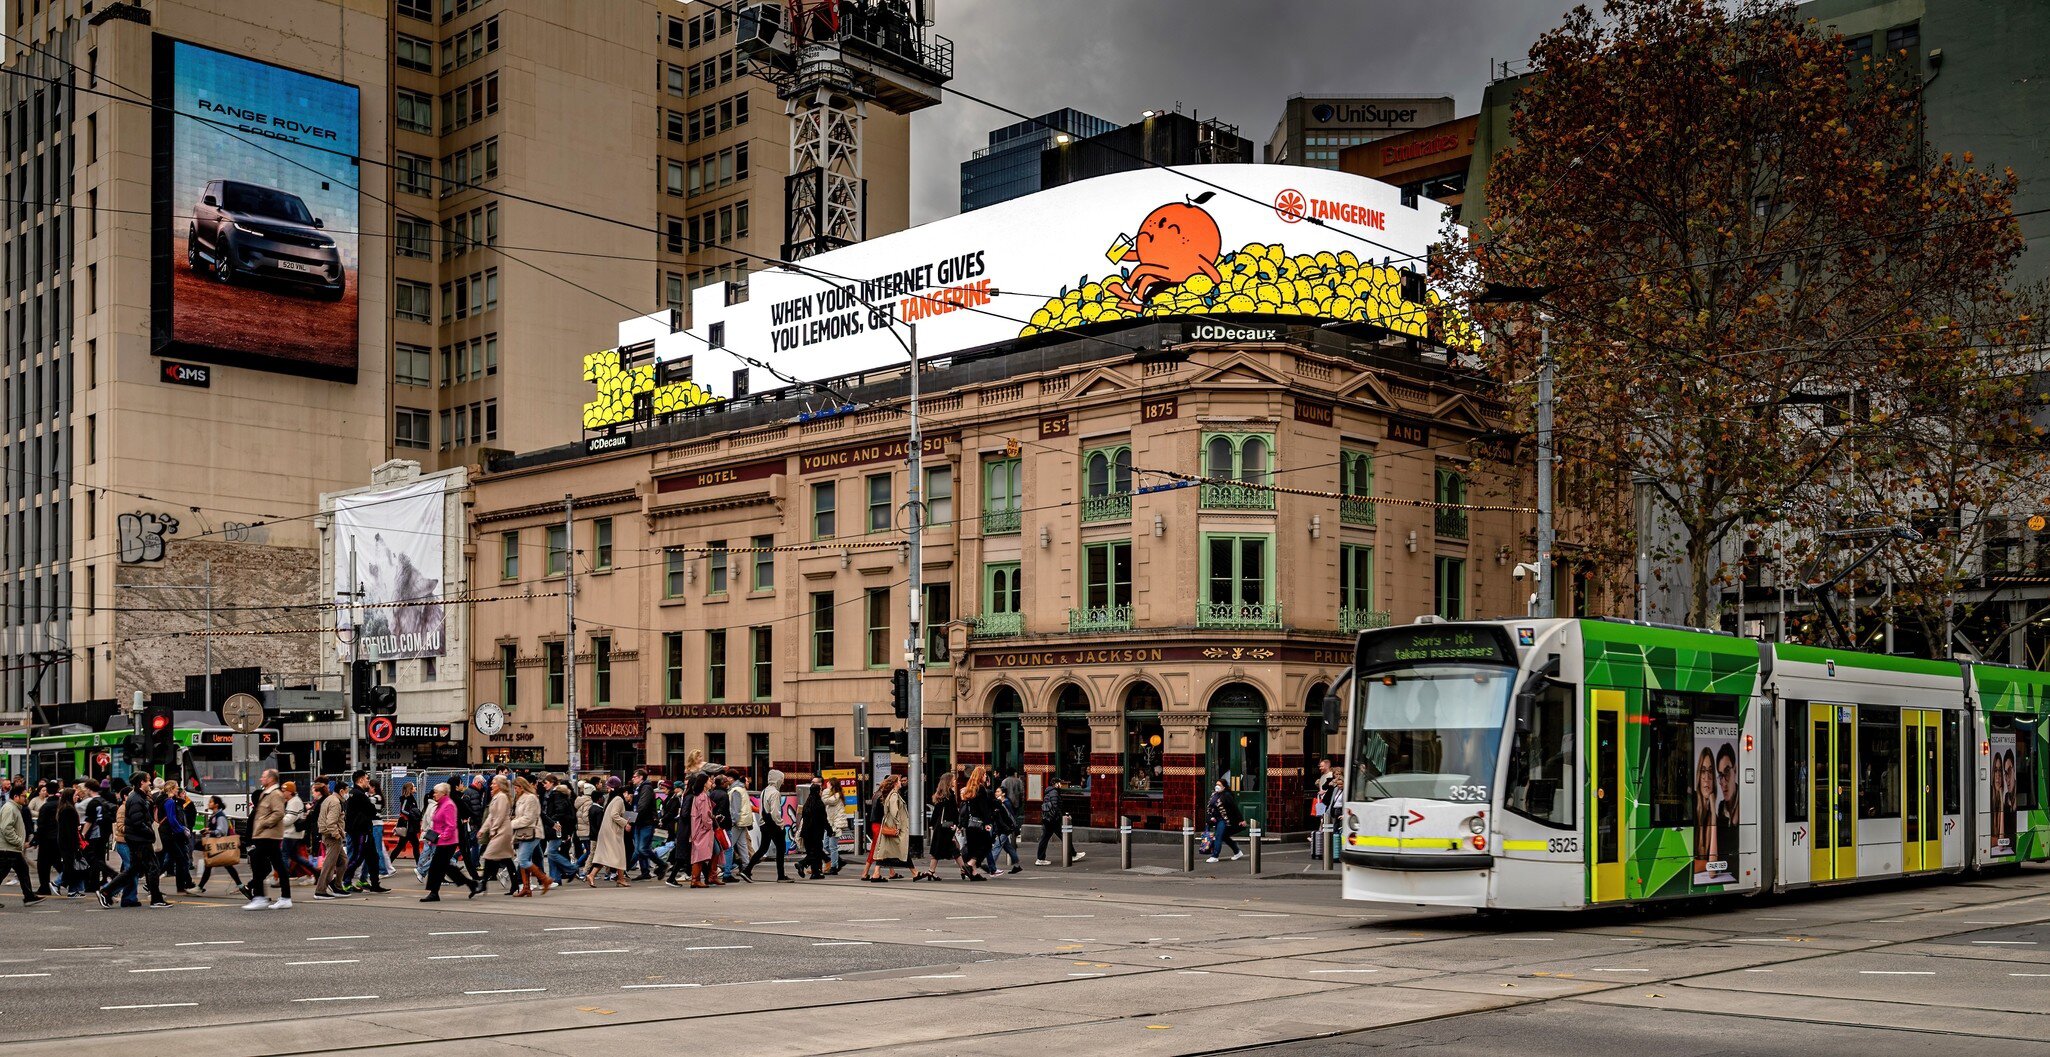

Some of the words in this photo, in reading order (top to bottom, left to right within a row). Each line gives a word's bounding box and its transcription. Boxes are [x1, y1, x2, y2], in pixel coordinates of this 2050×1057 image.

[198, 99, 267, 124] RANGE
[273, 117, 338, 141] ROVER
[1336, 104, 1417, 127] UniSuper
[1382, 135, 1458, 165] Emirates
[1310, 198, 1385, 231] TANGERINE
[771, 294, 812, 326] WHEN
[816, 284, 856, 315] YOUR
[860, 263, 934, 304] INTERNET
[937, 250, 985, 285] GIVES
[771, 325, 799, 353] YOU
[802, 310, 864, 346] LEMONS,
[868, 302, 896, 329] GET
[900, 278, 992, 323] TANGERINE
[1191, 325, 1277, 341] JCDecaux
[177, 366, 207, 382] QMS
[1146, 402, 1174, 419] 1875
[1295, 402, 1331, 422] YOUNG
[1394, 423, 1422, 442] AND
[589, 436, 627, 451] JCDecaux
[804, 454, 848, 470] YOUNG
[852, 448, 881, 462] AND
[884, 436, 953, 457] JACSON
[698, 470, 737, 486] HOTEL
[1412, 636, 1441, 647] Sorry
[1454, 633, 1474, 645] Not
[994, 652, 1054, 666] YOUNG
[1060, 655, 1068, 664] &
[1075, 648, 1163, 664] JACKSON
[1394, 648, 1427, 660] taking
[1430, 646, 1494, 659] passengers
[658, 705, 699, 716] YOUNG
[711, 704, 771, 716] JACKSON
[262, 734, 271, 742] 75
[489, 734, 513, 742] BOTTLE
[516, 733, 534, 742] SHOP
[583, 722, 607, 738] YOUNG
[606, 722, 640, 738] JACKSON
[1696, 726, 1716, 736] OSCAR
[1718, 727, 1738, 736] WYLEE
[1448, 785, 1487, 801] 3525
[235, 803, 246, 814] PT
[1388, 815, 1410, 832] PT
[1548, 838, 1578, 853] 3525
[1792, 831, 1801, 846] PT
